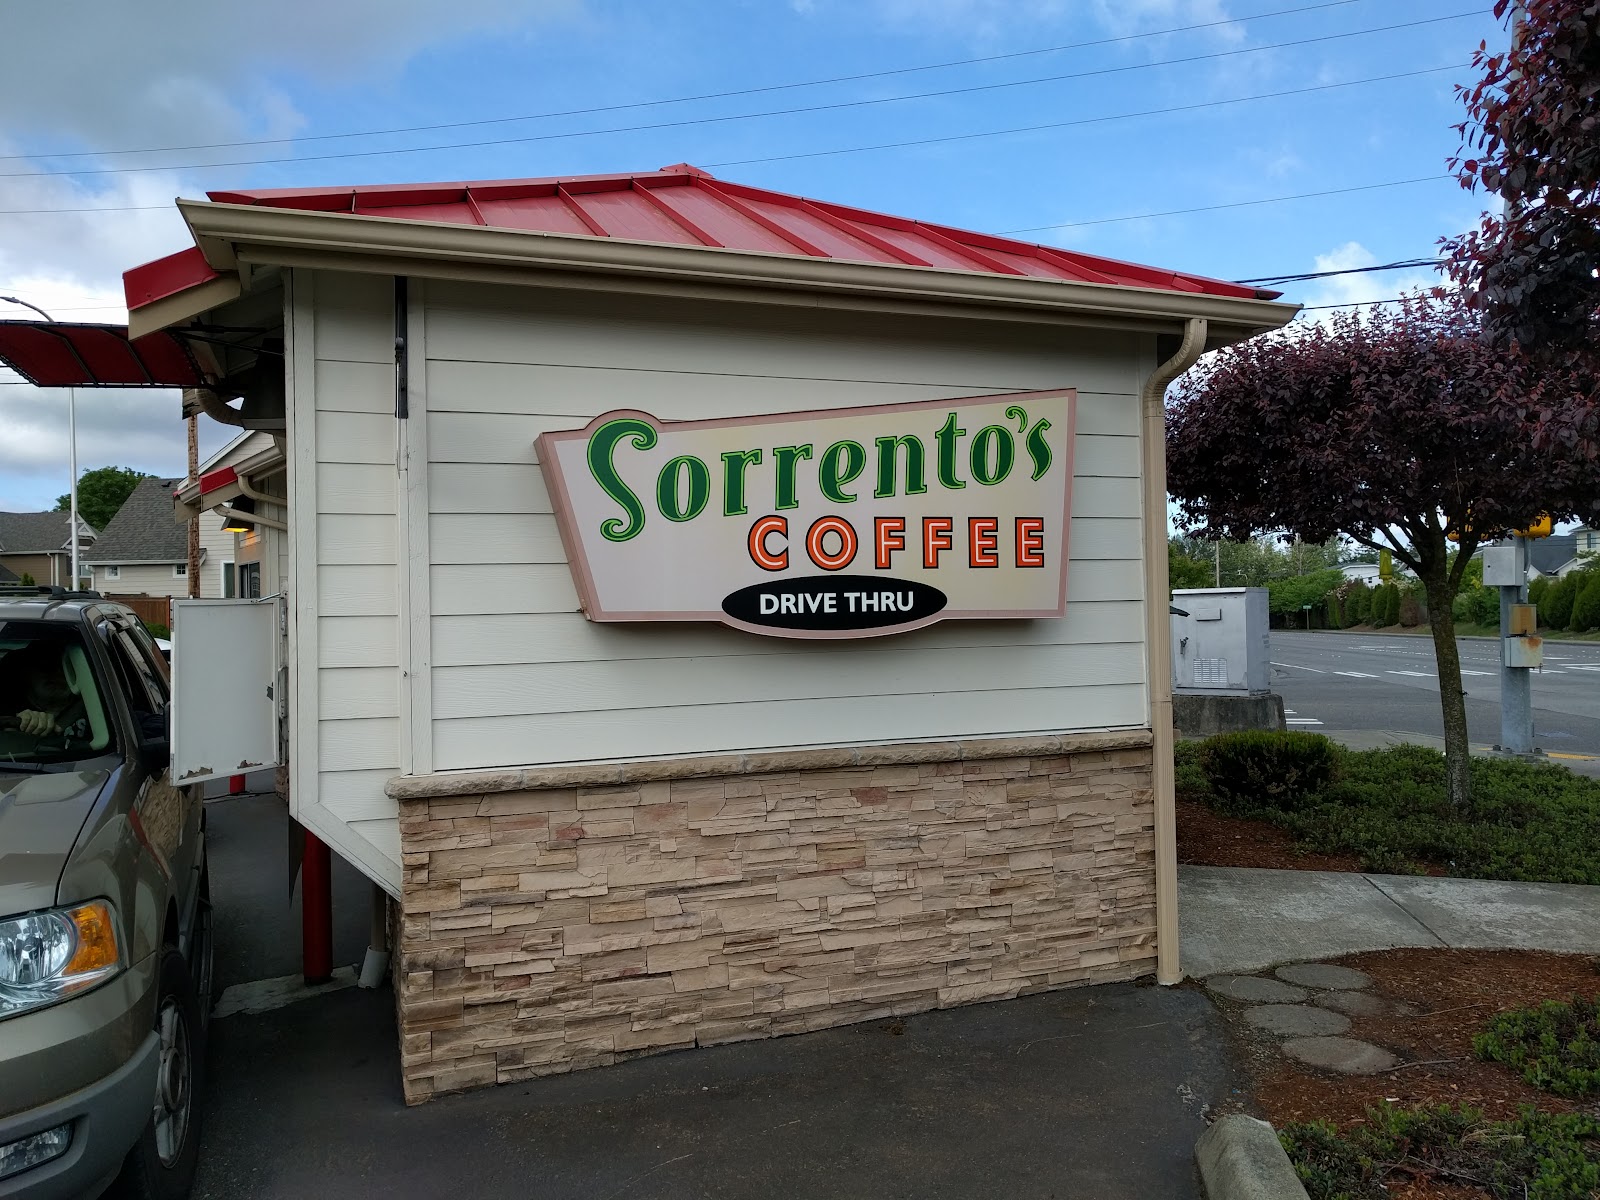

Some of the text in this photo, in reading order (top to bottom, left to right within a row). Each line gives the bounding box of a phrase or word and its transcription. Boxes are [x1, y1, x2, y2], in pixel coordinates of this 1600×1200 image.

[587, 405, 1052, 542] Sorrento's
[747, 515, 1045, 571] COFFEE
[759, 591, 914, 615] DRIVE THRU
